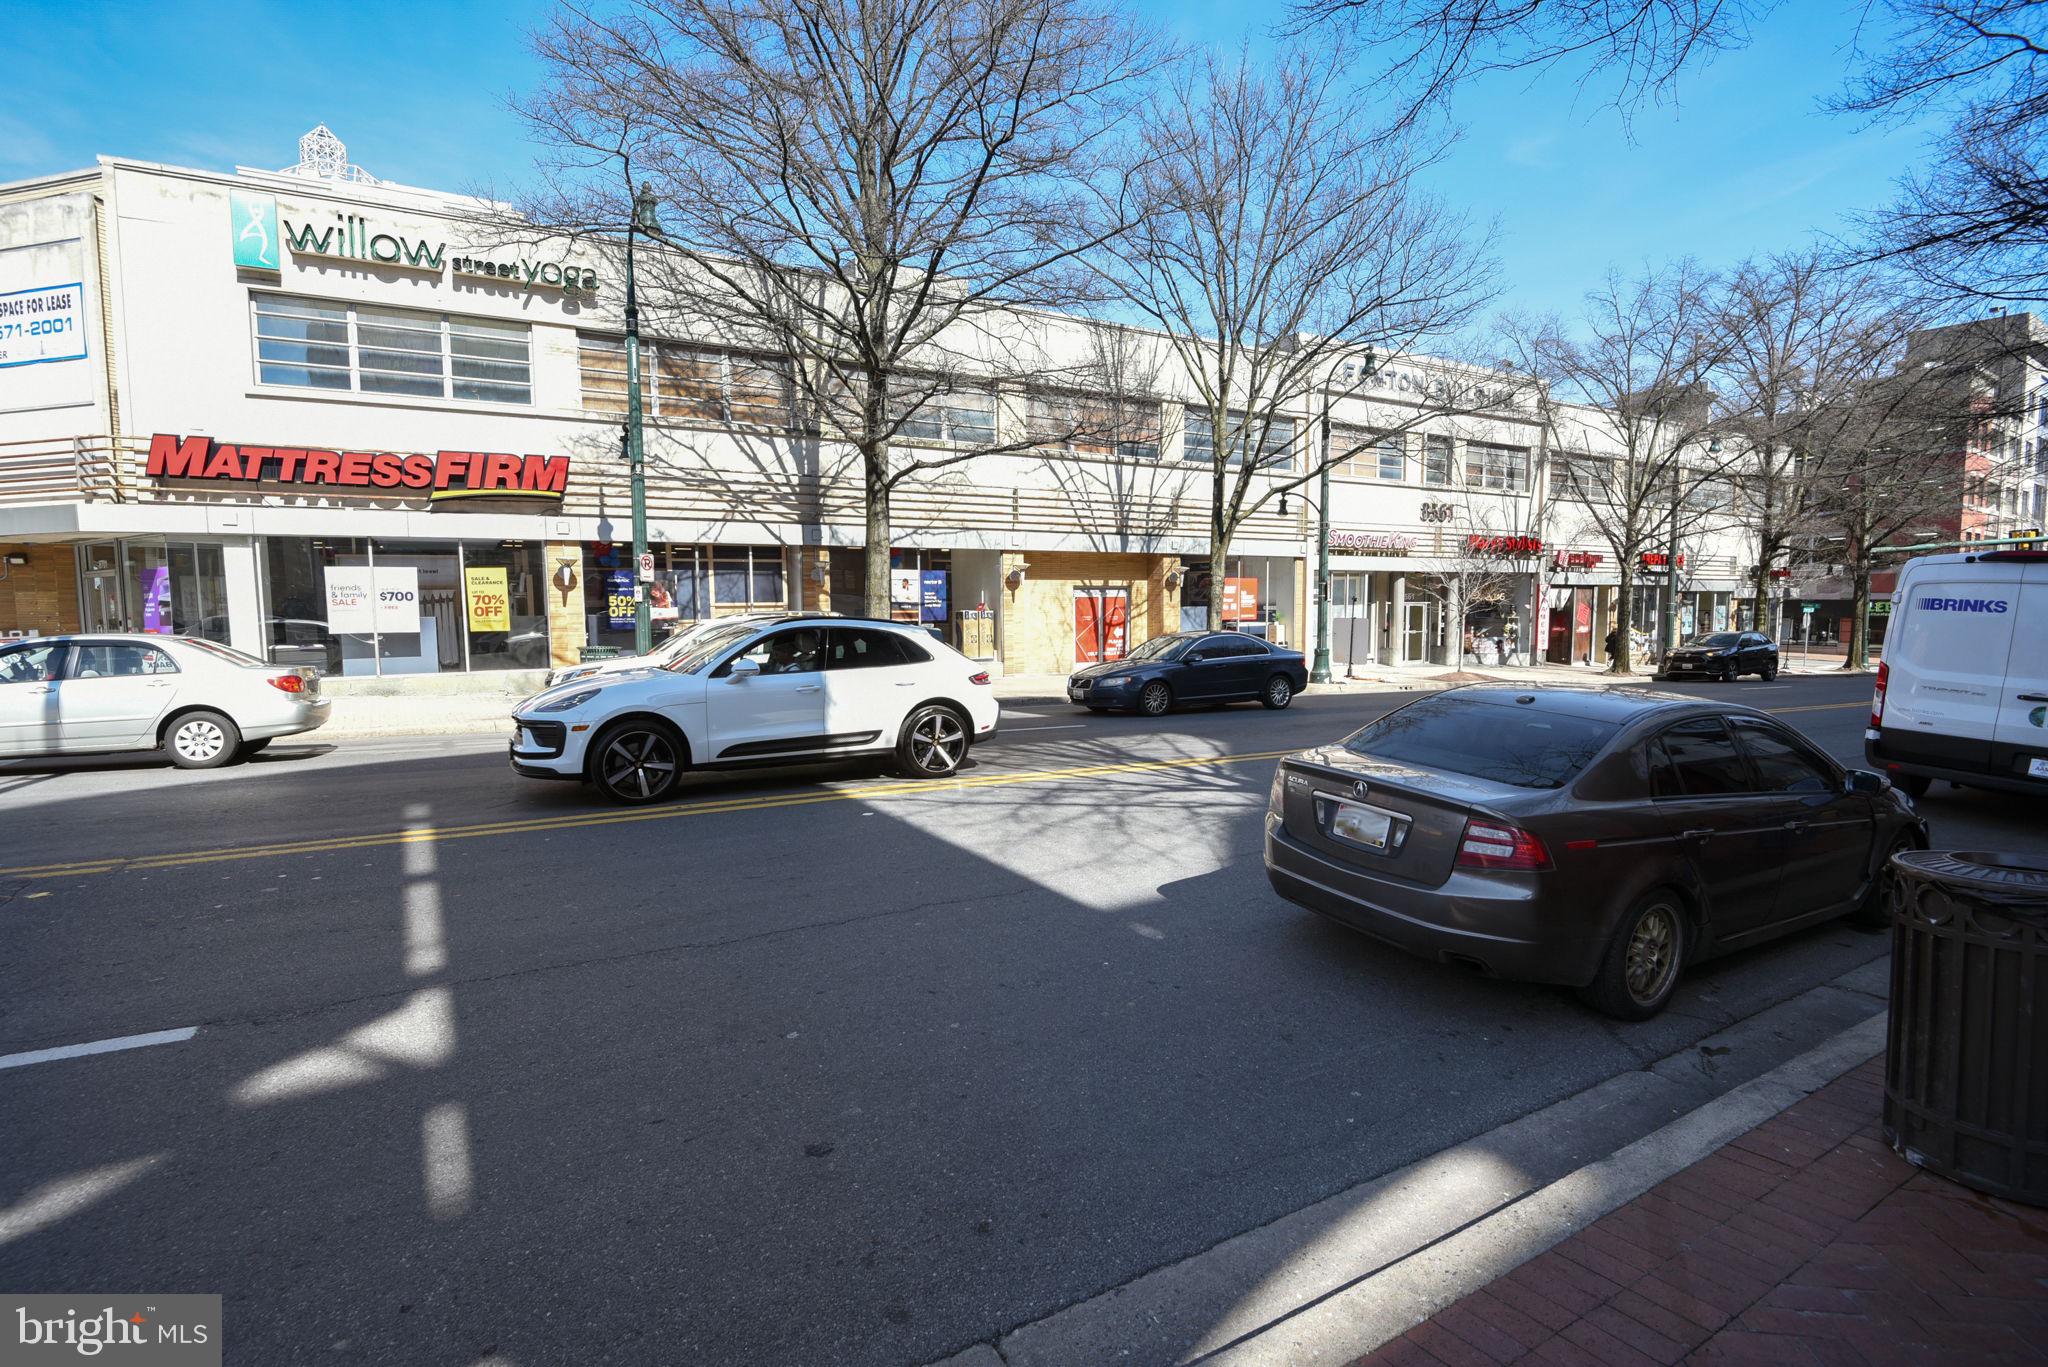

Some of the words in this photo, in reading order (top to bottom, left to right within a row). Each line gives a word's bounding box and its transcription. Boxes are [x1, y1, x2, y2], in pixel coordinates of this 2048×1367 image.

[283, 214, 446, 269] willow
[27, 297, 43, 314] FOR
[46, 293, 71, 311] LEASE
[380, 591, 414, 601] $700
[473, 594, 505, 606] 70%
[474, 605, 502, 617] OFF
[608, 606, 635, 617] OFF
[1929, 598, 2008, 613] BRINKS
[1288, 775, 1308, 786] ACURA
